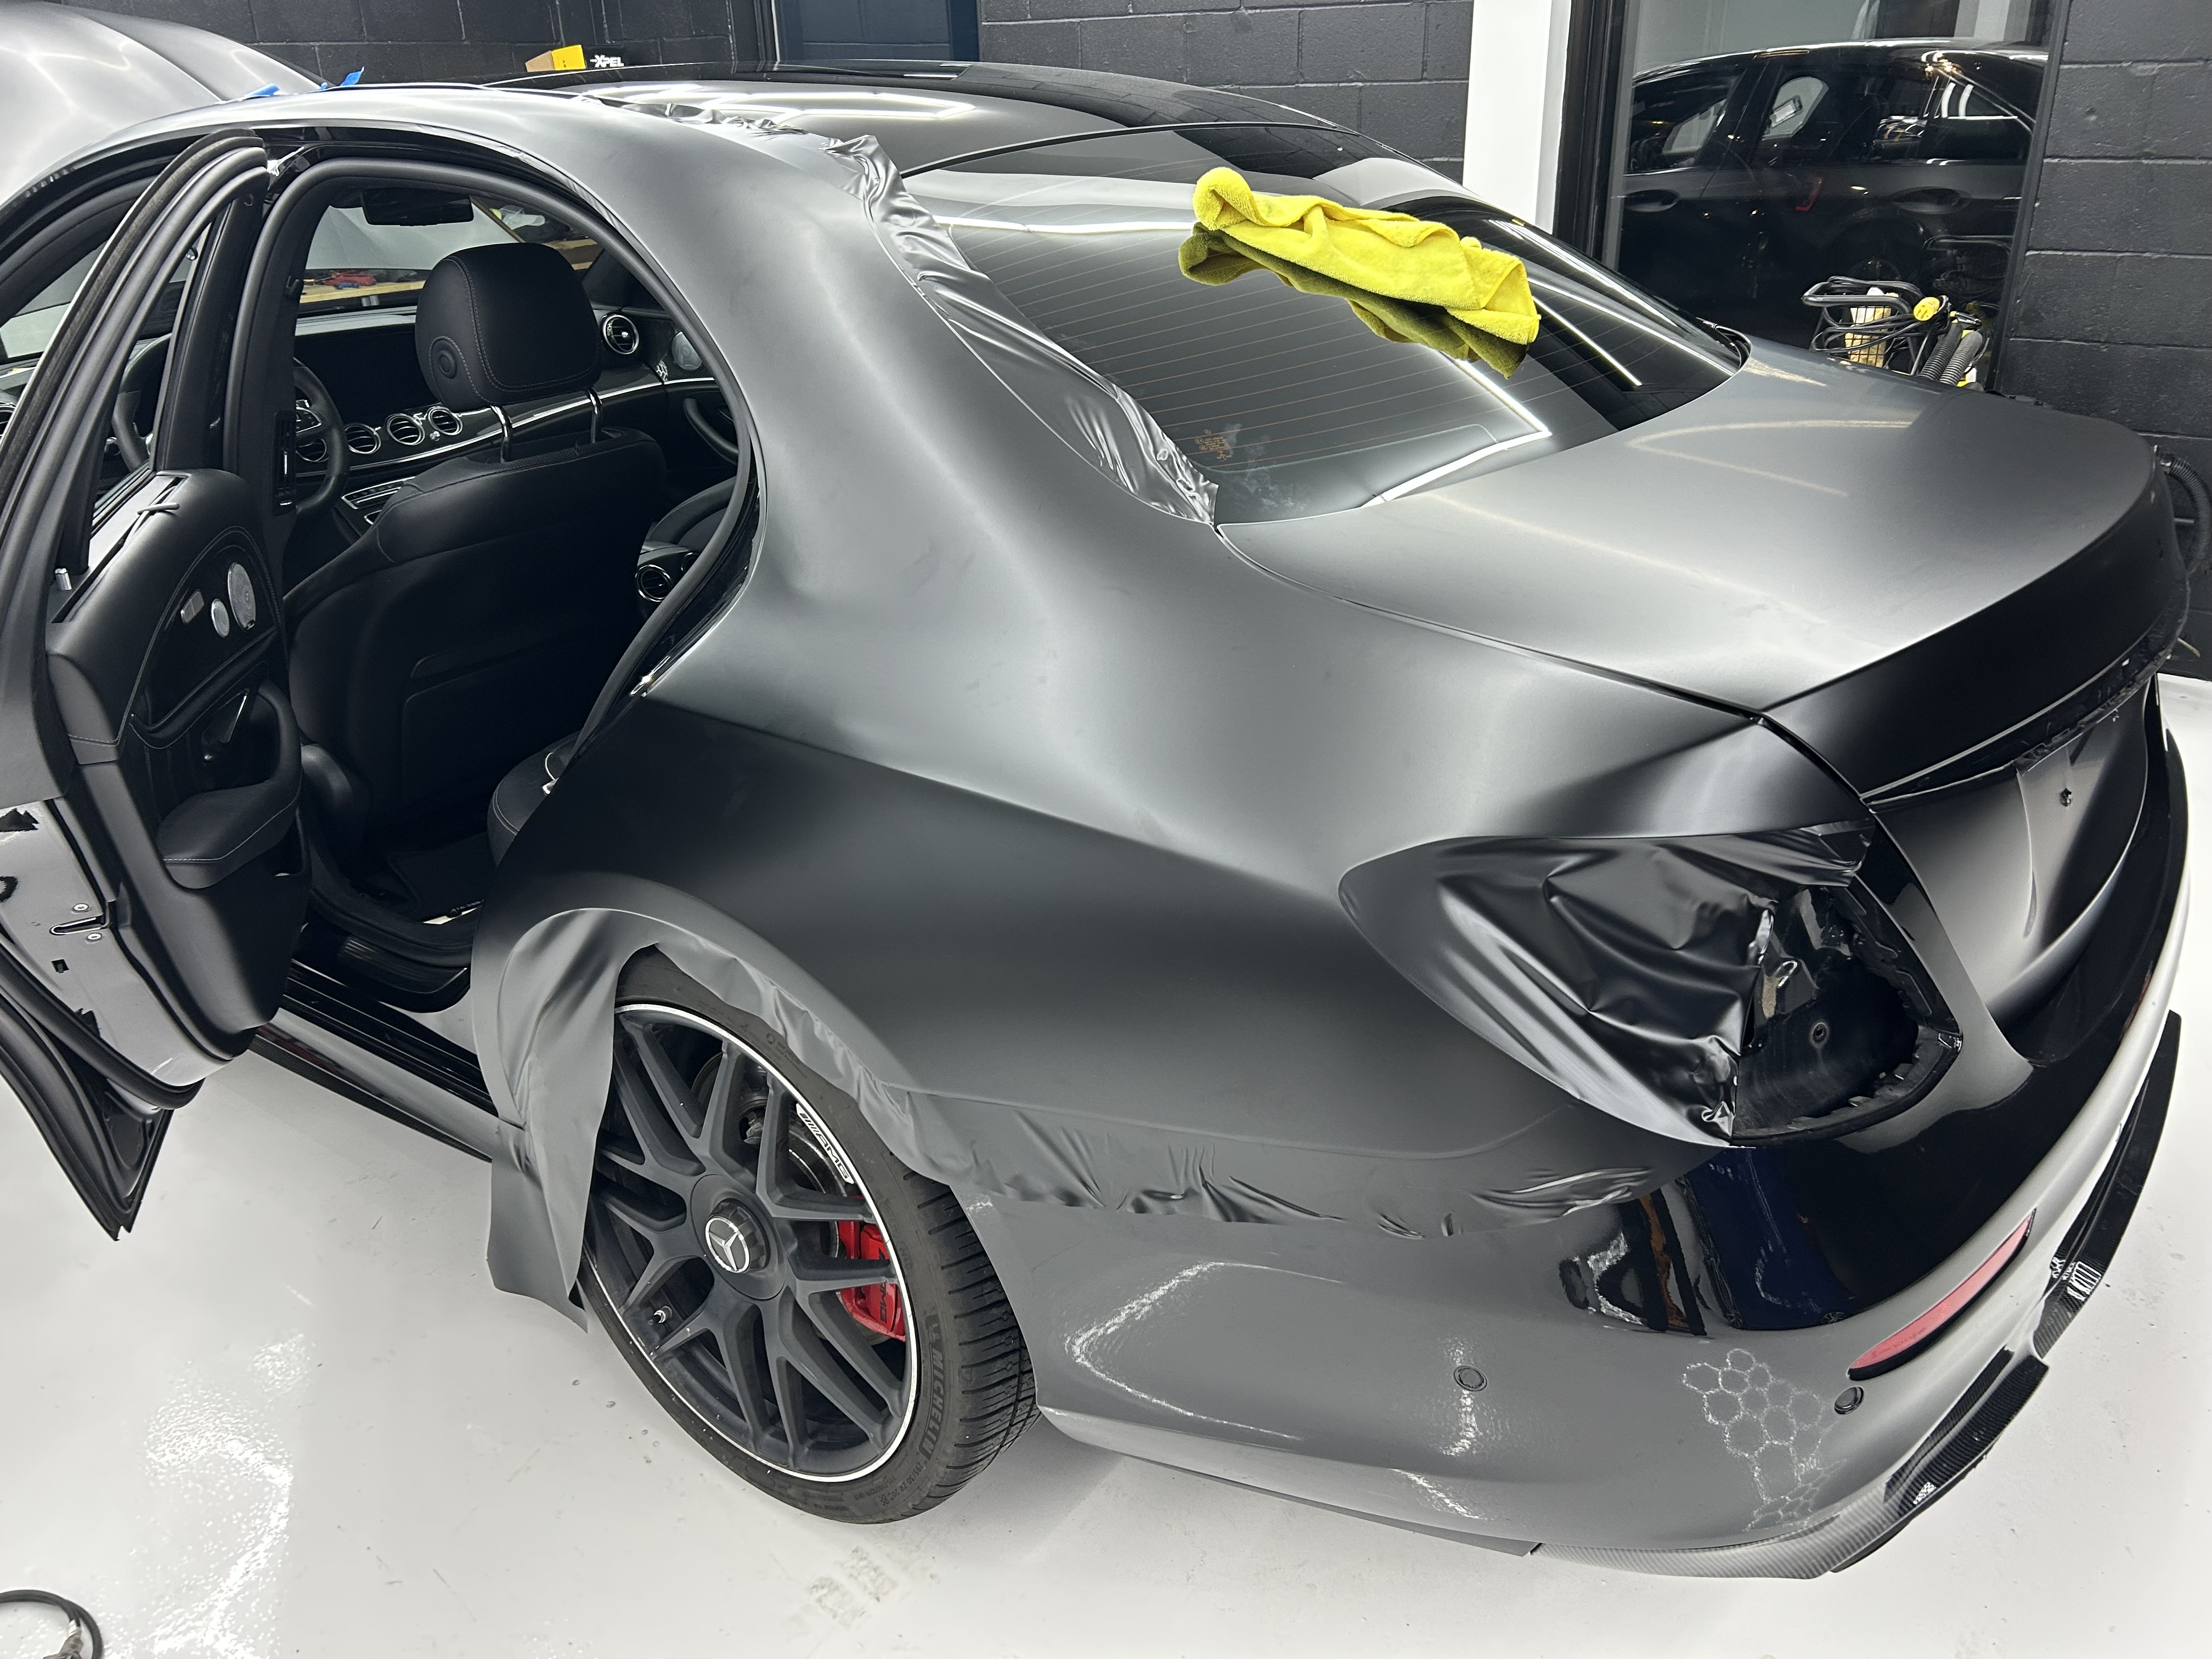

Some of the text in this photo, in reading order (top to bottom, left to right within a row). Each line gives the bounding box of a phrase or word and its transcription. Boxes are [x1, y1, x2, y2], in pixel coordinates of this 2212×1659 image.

[595, 55, 624, 67] XPEL
[922, 1348, 945, 1459] MICHELIN
[906, 1461, 924, 1485] 295/30
[899, 1482, 908, 1492] ZR
